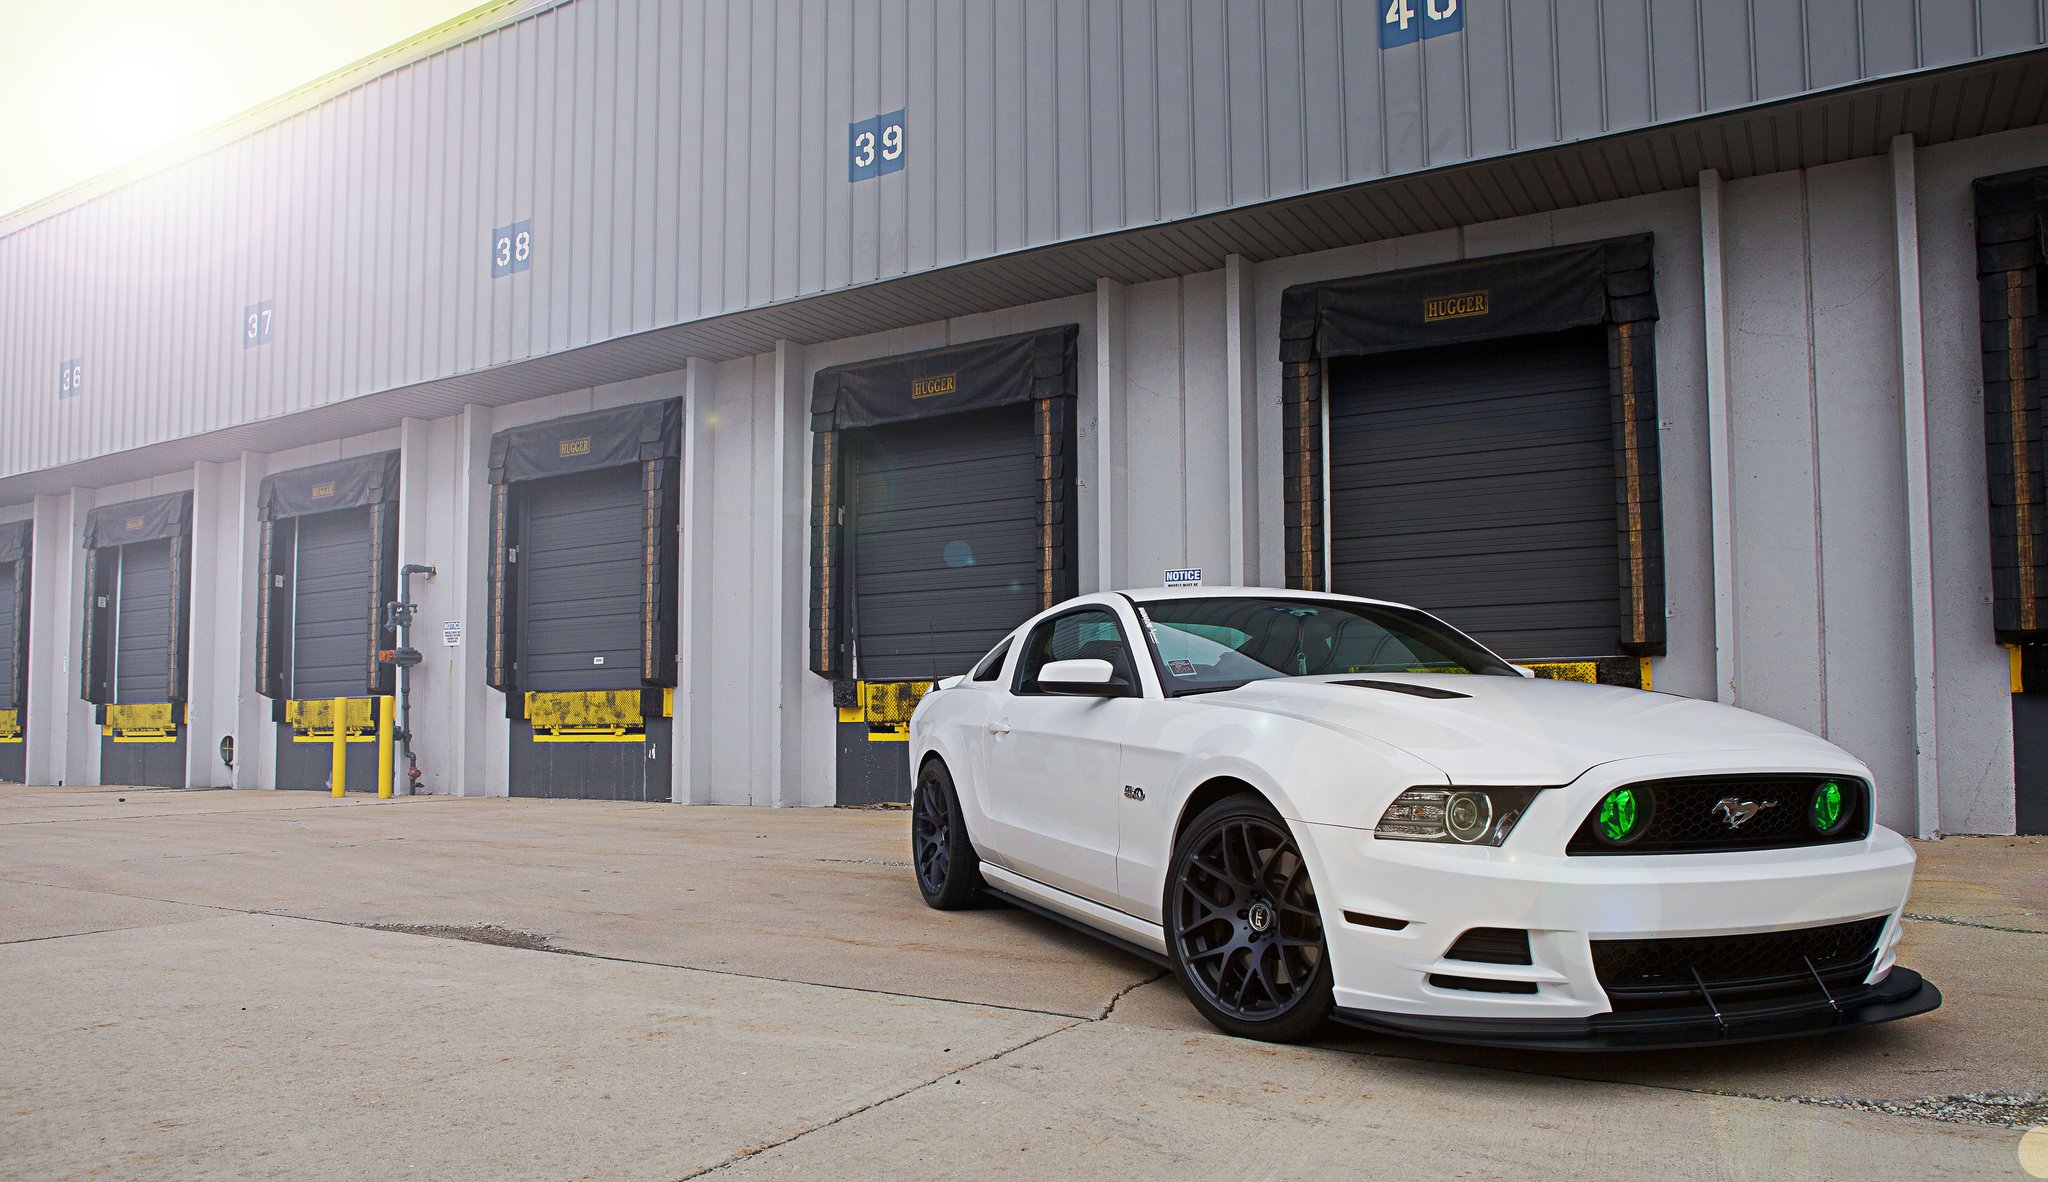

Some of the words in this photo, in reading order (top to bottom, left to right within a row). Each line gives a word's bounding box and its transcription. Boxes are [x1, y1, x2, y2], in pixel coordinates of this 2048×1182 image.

[855, 124, 903, 168] 39
[496, 231, 530, 267] 38
[1427, 298, 1485, 318] HUGGER
[248, 309, 272, 339] 37
[63, 366, 80, 391] 36
[915, 376, 954, 396] HUGGER
[561, 440, 588, 455] HUGGER
[1166, 571, 1200, 581] NOTICE
